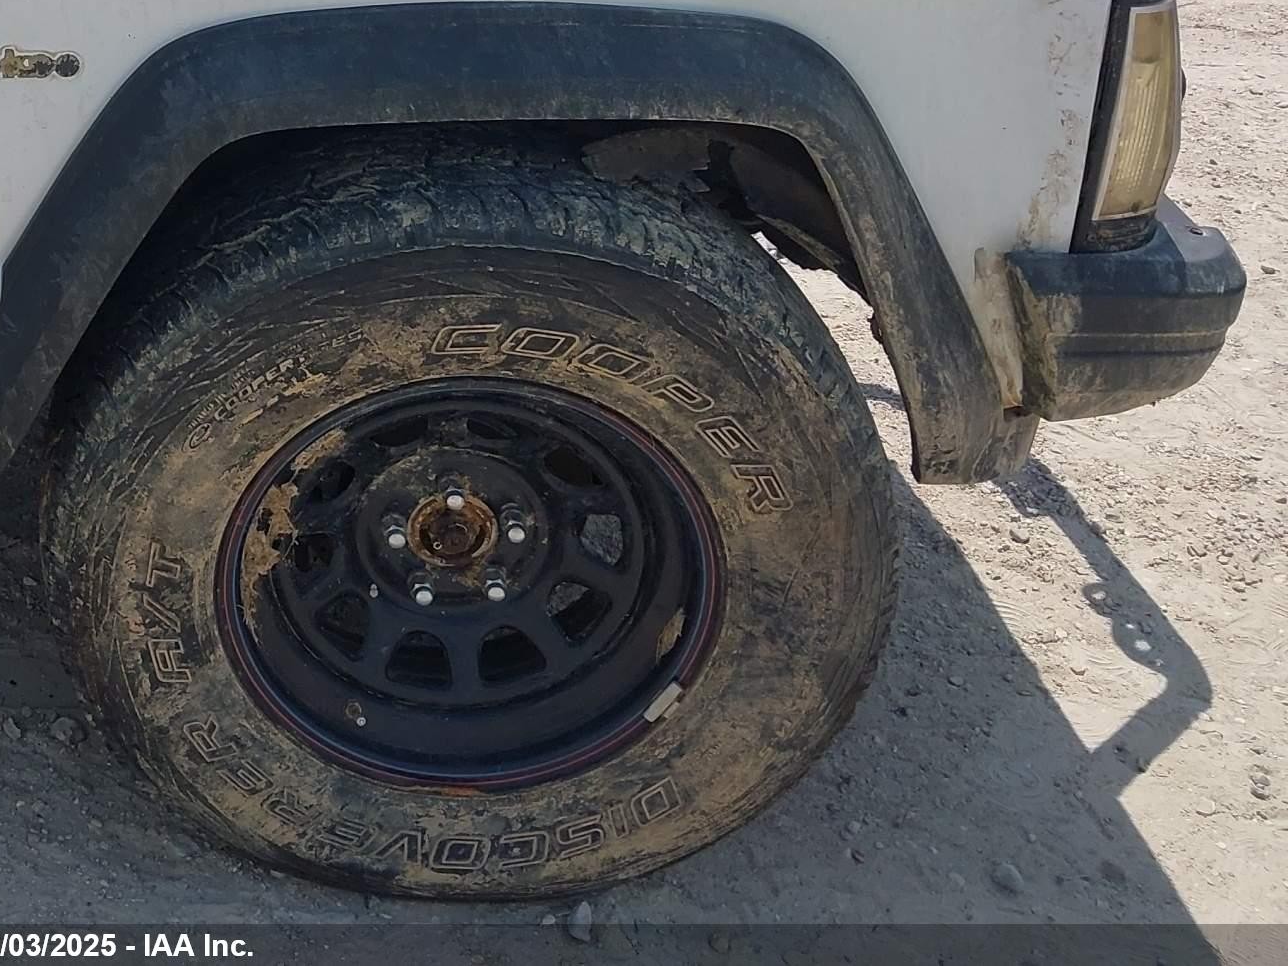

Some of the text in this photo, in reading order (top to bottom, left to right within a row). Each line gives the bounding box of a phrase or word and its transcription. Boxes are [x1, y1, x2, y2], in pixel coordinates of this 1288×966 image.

[430, 322, 794, 514] COOPER
[142, 541, 685, 872] DISCOVERER A/T
